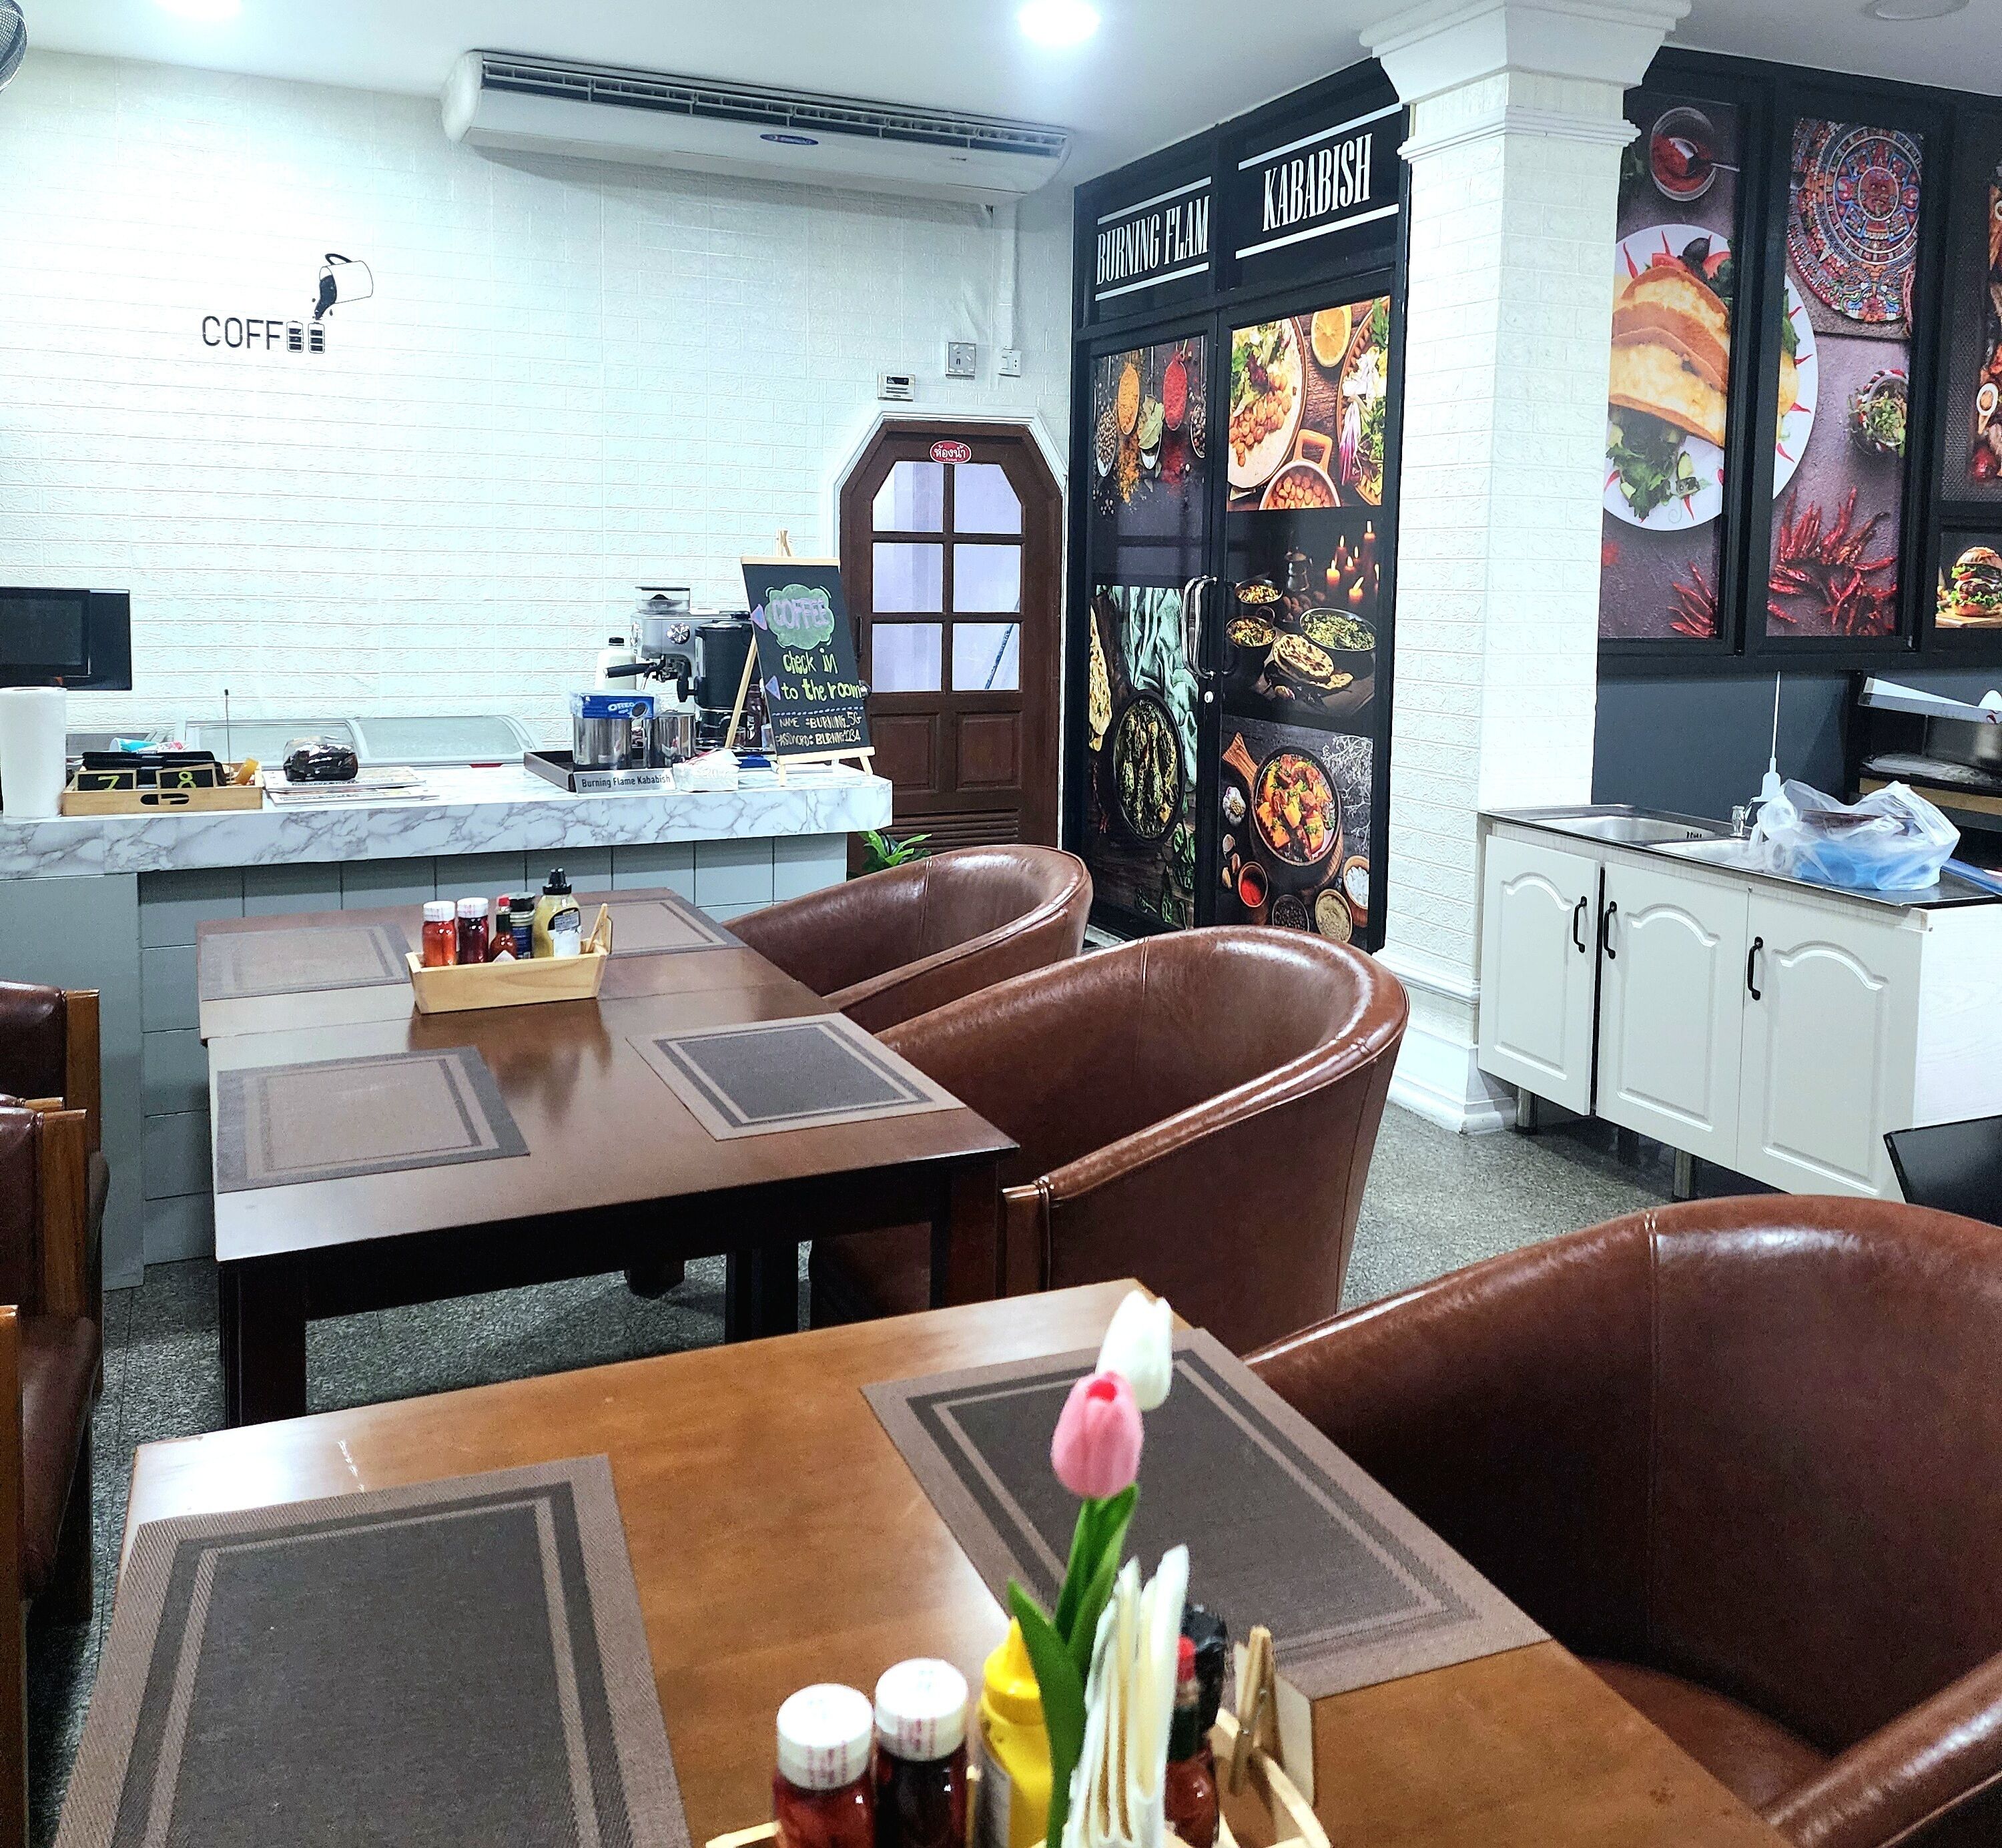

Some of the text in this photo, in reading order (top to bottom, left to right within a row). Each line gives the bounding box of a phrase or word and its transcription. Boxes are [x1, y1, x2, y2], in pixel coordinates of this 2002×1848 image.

[1263, 133, 1373, 232] KABABISH
[1096, 214, 1160, 286] BURNING
[934, 444, 966, 458] ห้องน้ำ
[771, 597, 829, 630] COFFEE
[783, 647, 838, 675] check in
[781, 678, 862, 701] to the room
[607, 701, 635, 712] OREO
[582, 773, 671, 788] Burning Flame Kababish
